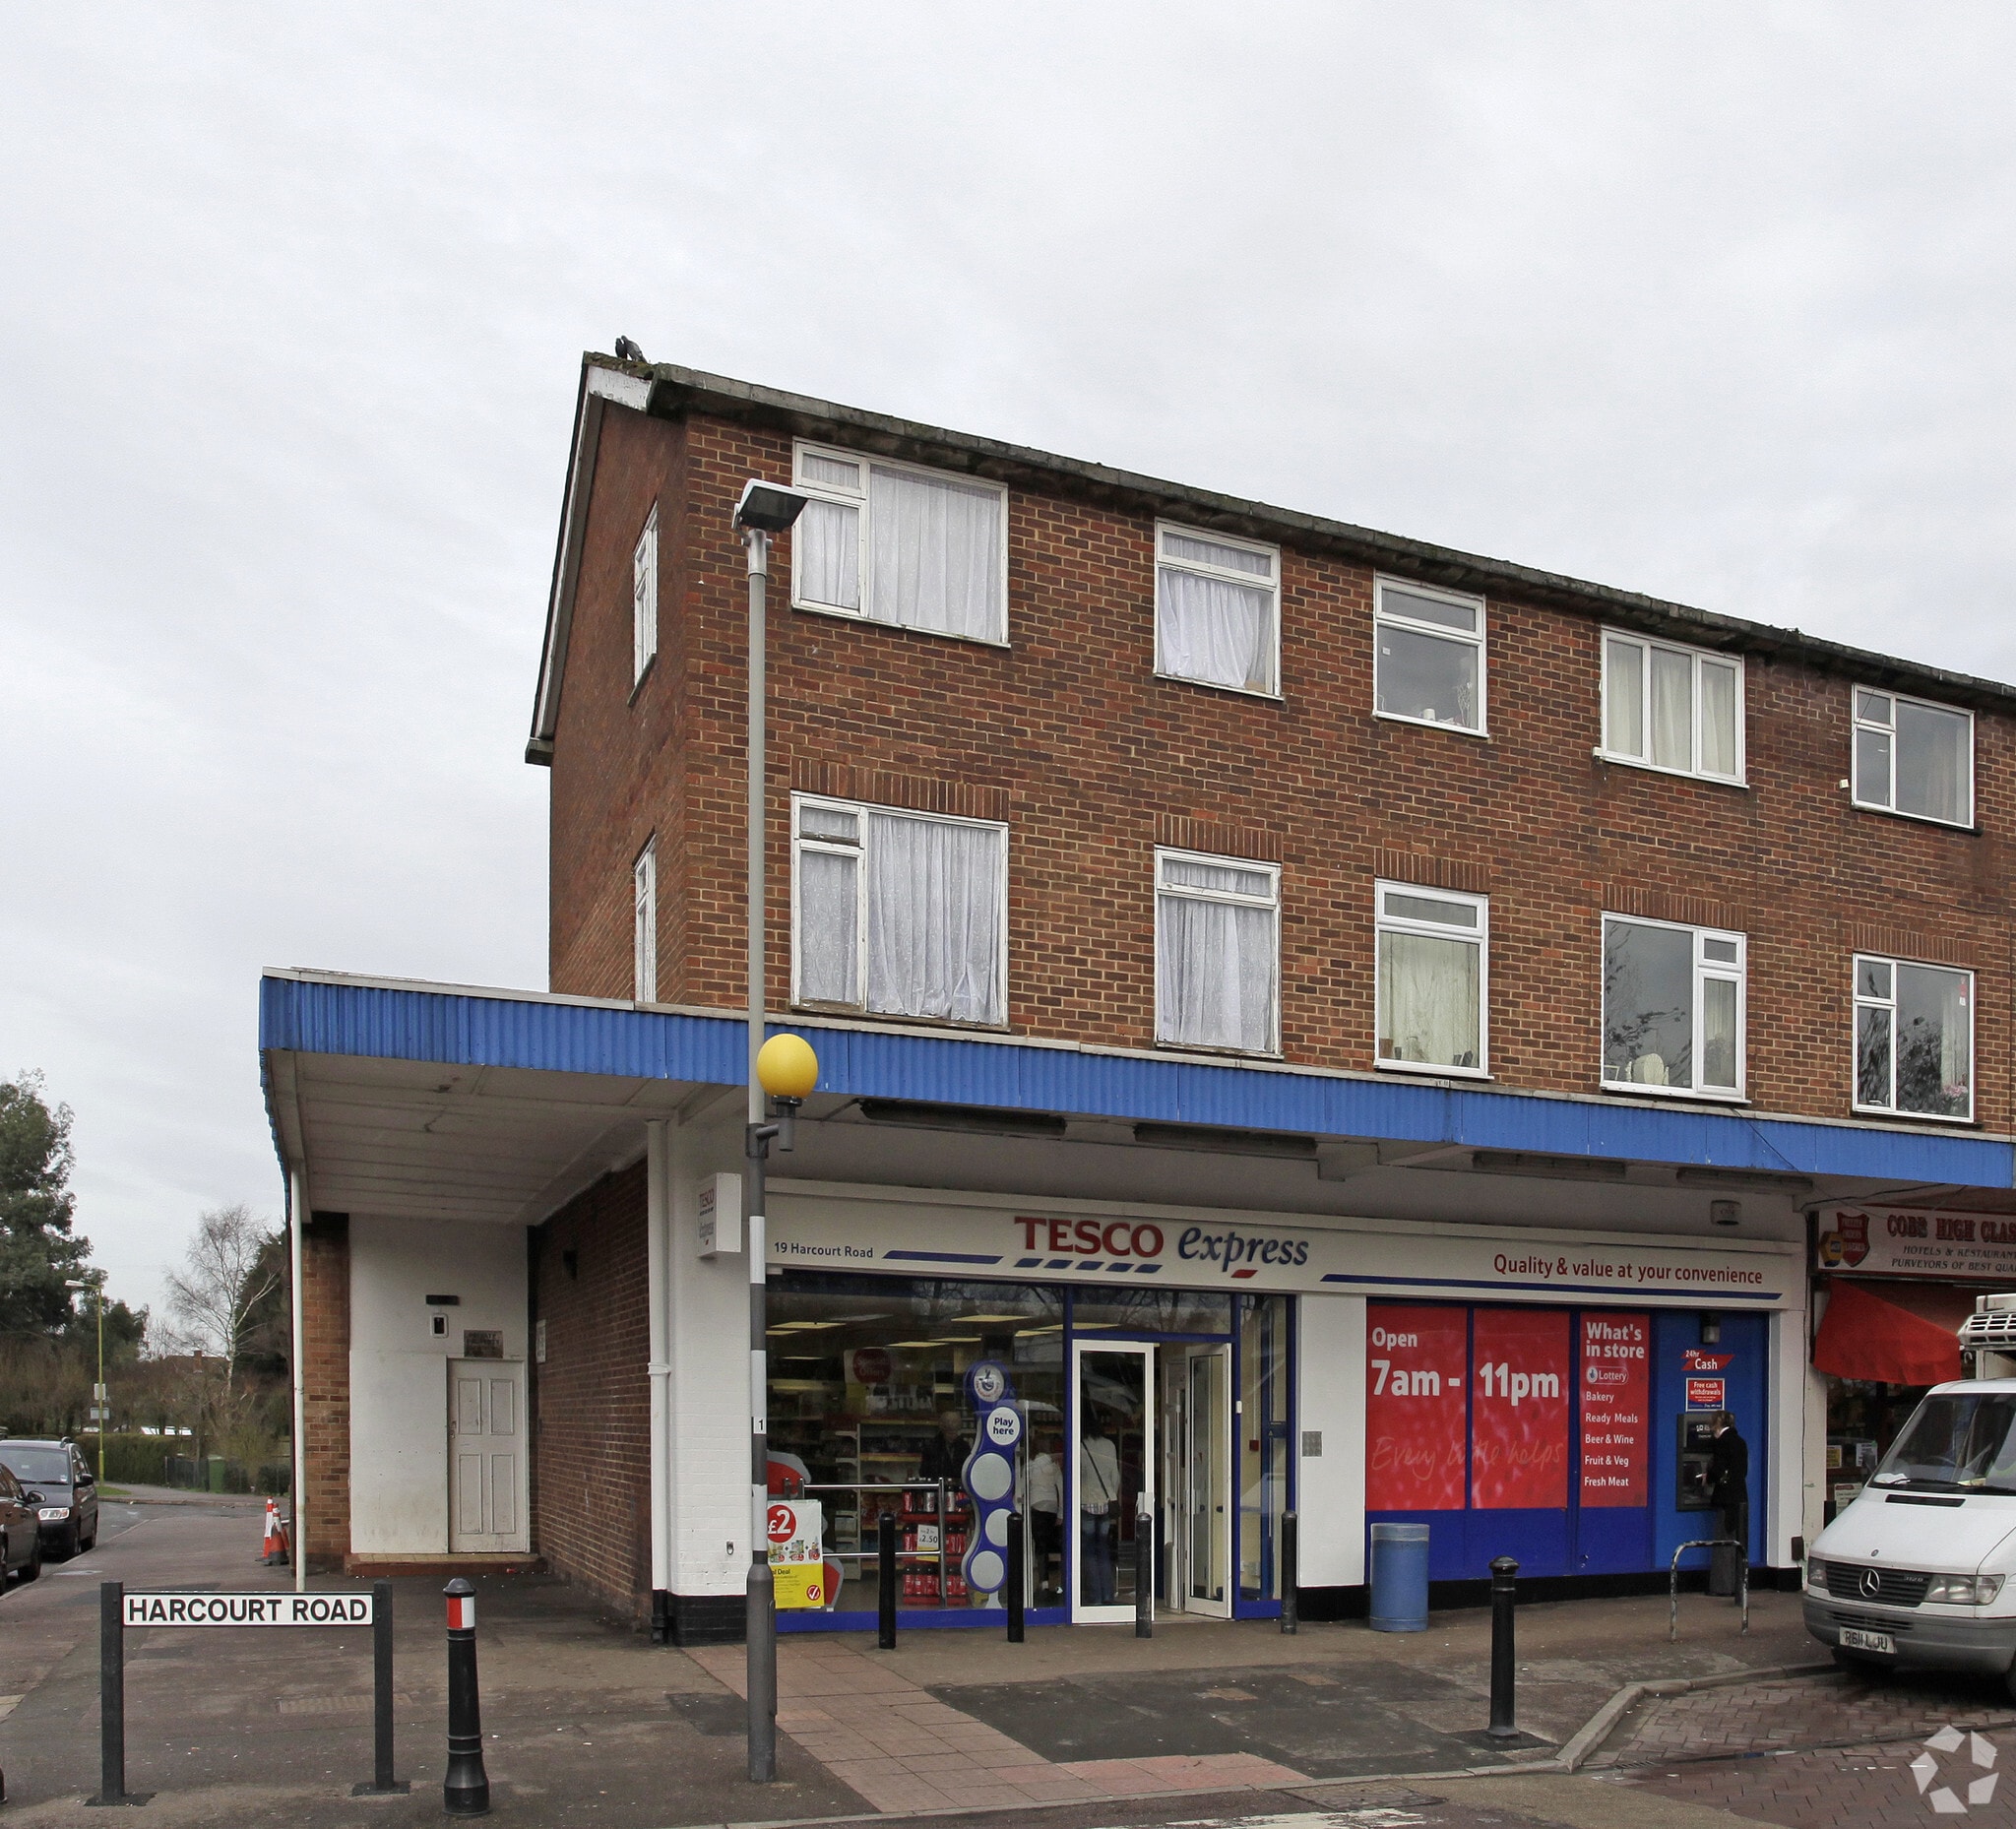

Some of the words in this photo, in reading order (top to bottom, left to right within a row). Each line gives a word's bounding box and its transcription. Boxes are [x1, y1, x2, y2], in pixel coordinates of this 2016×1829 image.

[1935, 1218, 1976, 1241] HIGH
[774, 1242, 788, 1253] 19
[790, 1243, 842, 1256] Harcourt
[845, 1245, 873, 1258] Road
[1014, 1216, 1164, 1257] TESCO
[1178, 1228, 1309, 1272] express
[1903, 1245, 1941, 1256] HOTELS
[1945, 1247, 1954, 1257] &
[1493, 1254, 1553, 1279] Quality
[1556, 1257, 1568, 1276] &
[1572, 1259, 1613, 1278] value
[1617, 1262, 1633, 1279] at
[1638, 1264, 1671, 1282] your
[1674, 1266, 1763, 1285] convenience
[1891, 1258, 1948, 1270] PURVEYORS
[1951, 1261, 1965, 1270] OF
[1968, 1262, 1992, 1272] BEST
[1586, 1321, 1642, 1341] What's
[1371, 1327, 1418, 1352] Open
[1586, 1339, 1601, 1357] in
[1604, 1343, 1645, 1359] store
[1694, 1357, 1718, 1369] Cash
[1371, 1359, 1440, 1396] 7am
[1479, 1362, 1559, 1406] 11pm
[1599, 1370, 1626, 1383] Lottery
[1586, 1391, 1614, 1404] Bakery
[758, 1419, 764, 1430] 1
[994, 1418, 1013, 1427] Play
[1585, 1412, 1611, 1425] Ready
[1614, 1413, 1638, 1423] Meals
[993, 1426, 1014, 1435] here
[1585, 1433, 1604, 1444] Beer
[1605, 1433, 1611, 1444] &
[1613, 1434, 1634, 1444] Wine
[1371, 1436, 1436, 1481] Every
[1507, 1438, 1564, 1472] helps
[1584, 1455, 1604, 1466] Fruit
[1605, 1455, 1611, 1466] &
[1613, 1455, 1629, 1468] Veg
[1584, 1477, 1606, 1486] Fresh
[1607, 1477, 1629, 1486] Meat
[768, 1509, 792, 1535] £2
[129, 1599, 282, 1621] HARCOURT
[292, 1599, 367, 1621] ROAD
